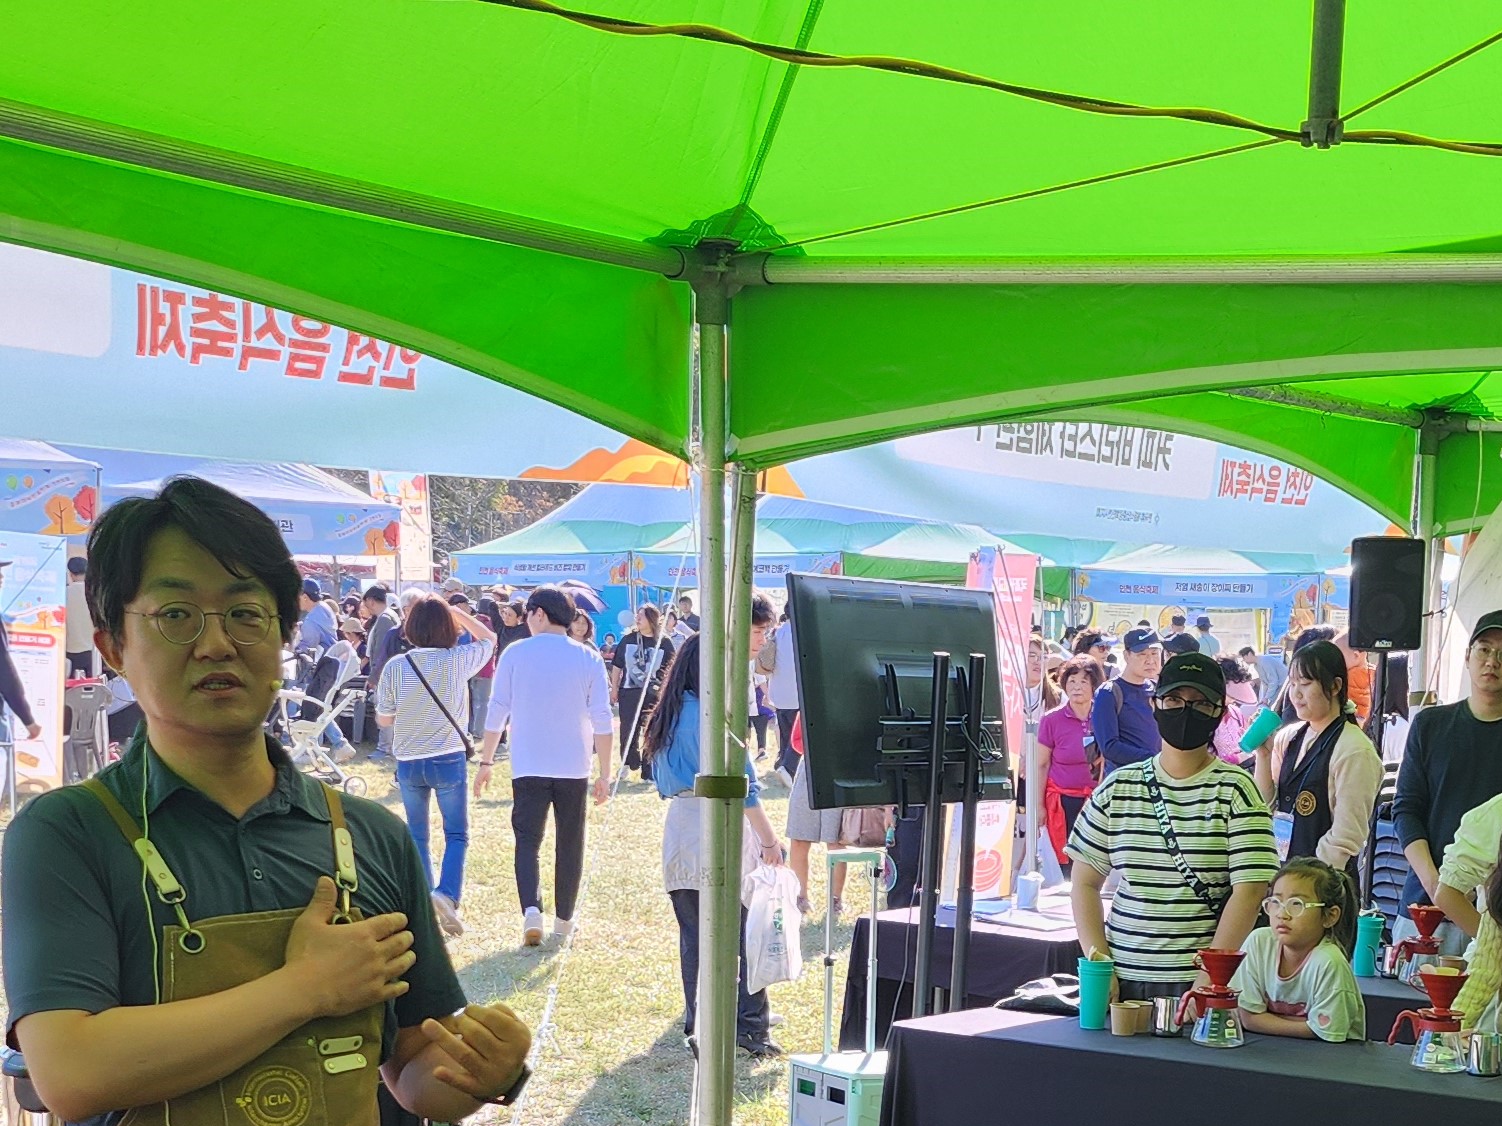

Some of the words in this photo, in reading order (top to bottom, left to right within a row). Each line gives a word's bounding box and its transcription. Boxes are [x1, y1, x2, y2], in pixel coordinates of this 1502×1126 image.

[1154, 800, 1171, 835] HIYA
[1172, 852, 1198, 887] HIYA
[263, 1093, 291, 1107] ICIA
